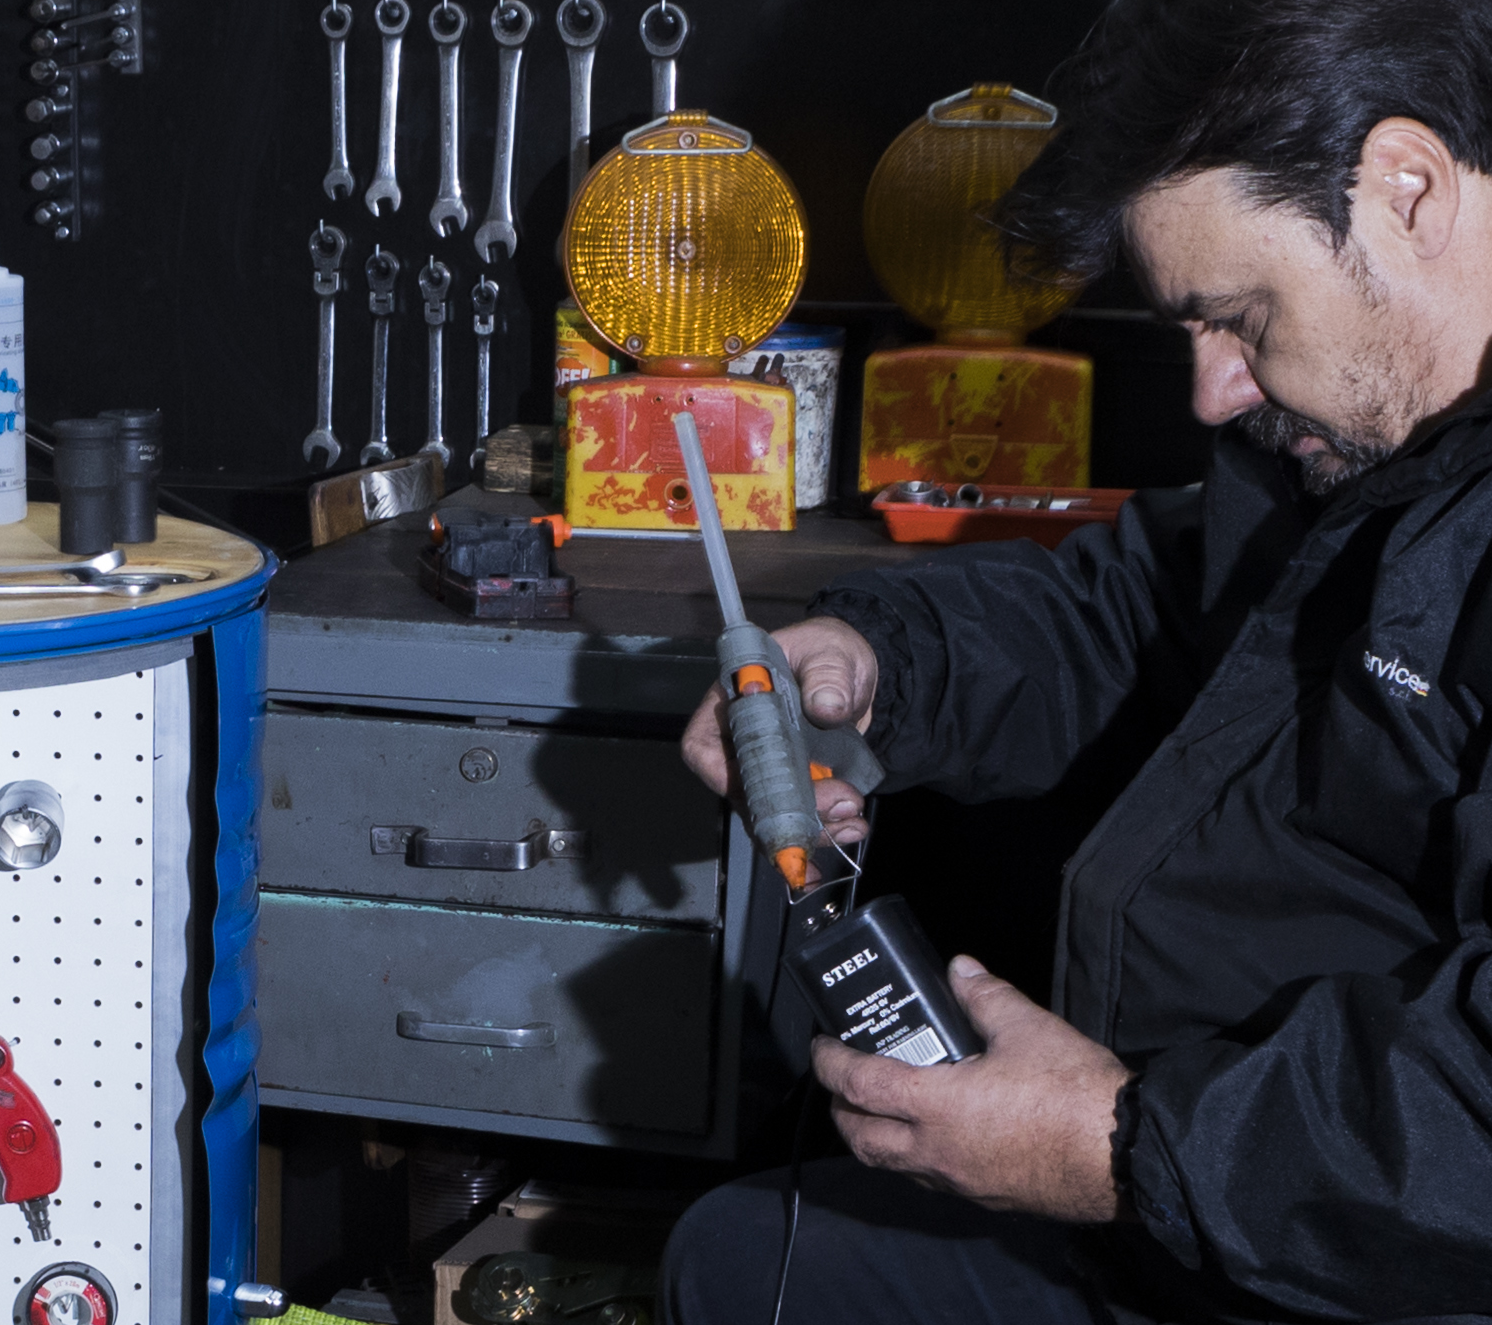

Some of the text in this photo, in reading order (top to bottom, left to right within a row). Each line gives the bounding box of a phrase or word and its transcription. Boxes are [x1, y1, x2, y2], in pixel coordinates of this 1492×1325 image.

[822, 948, 878, 987] STEEL
[866, 984, 893, 1005] BATTERY
[890, 991, 921, 1011] Cadmium
[850, 1018, 875, 1035] Mercury
